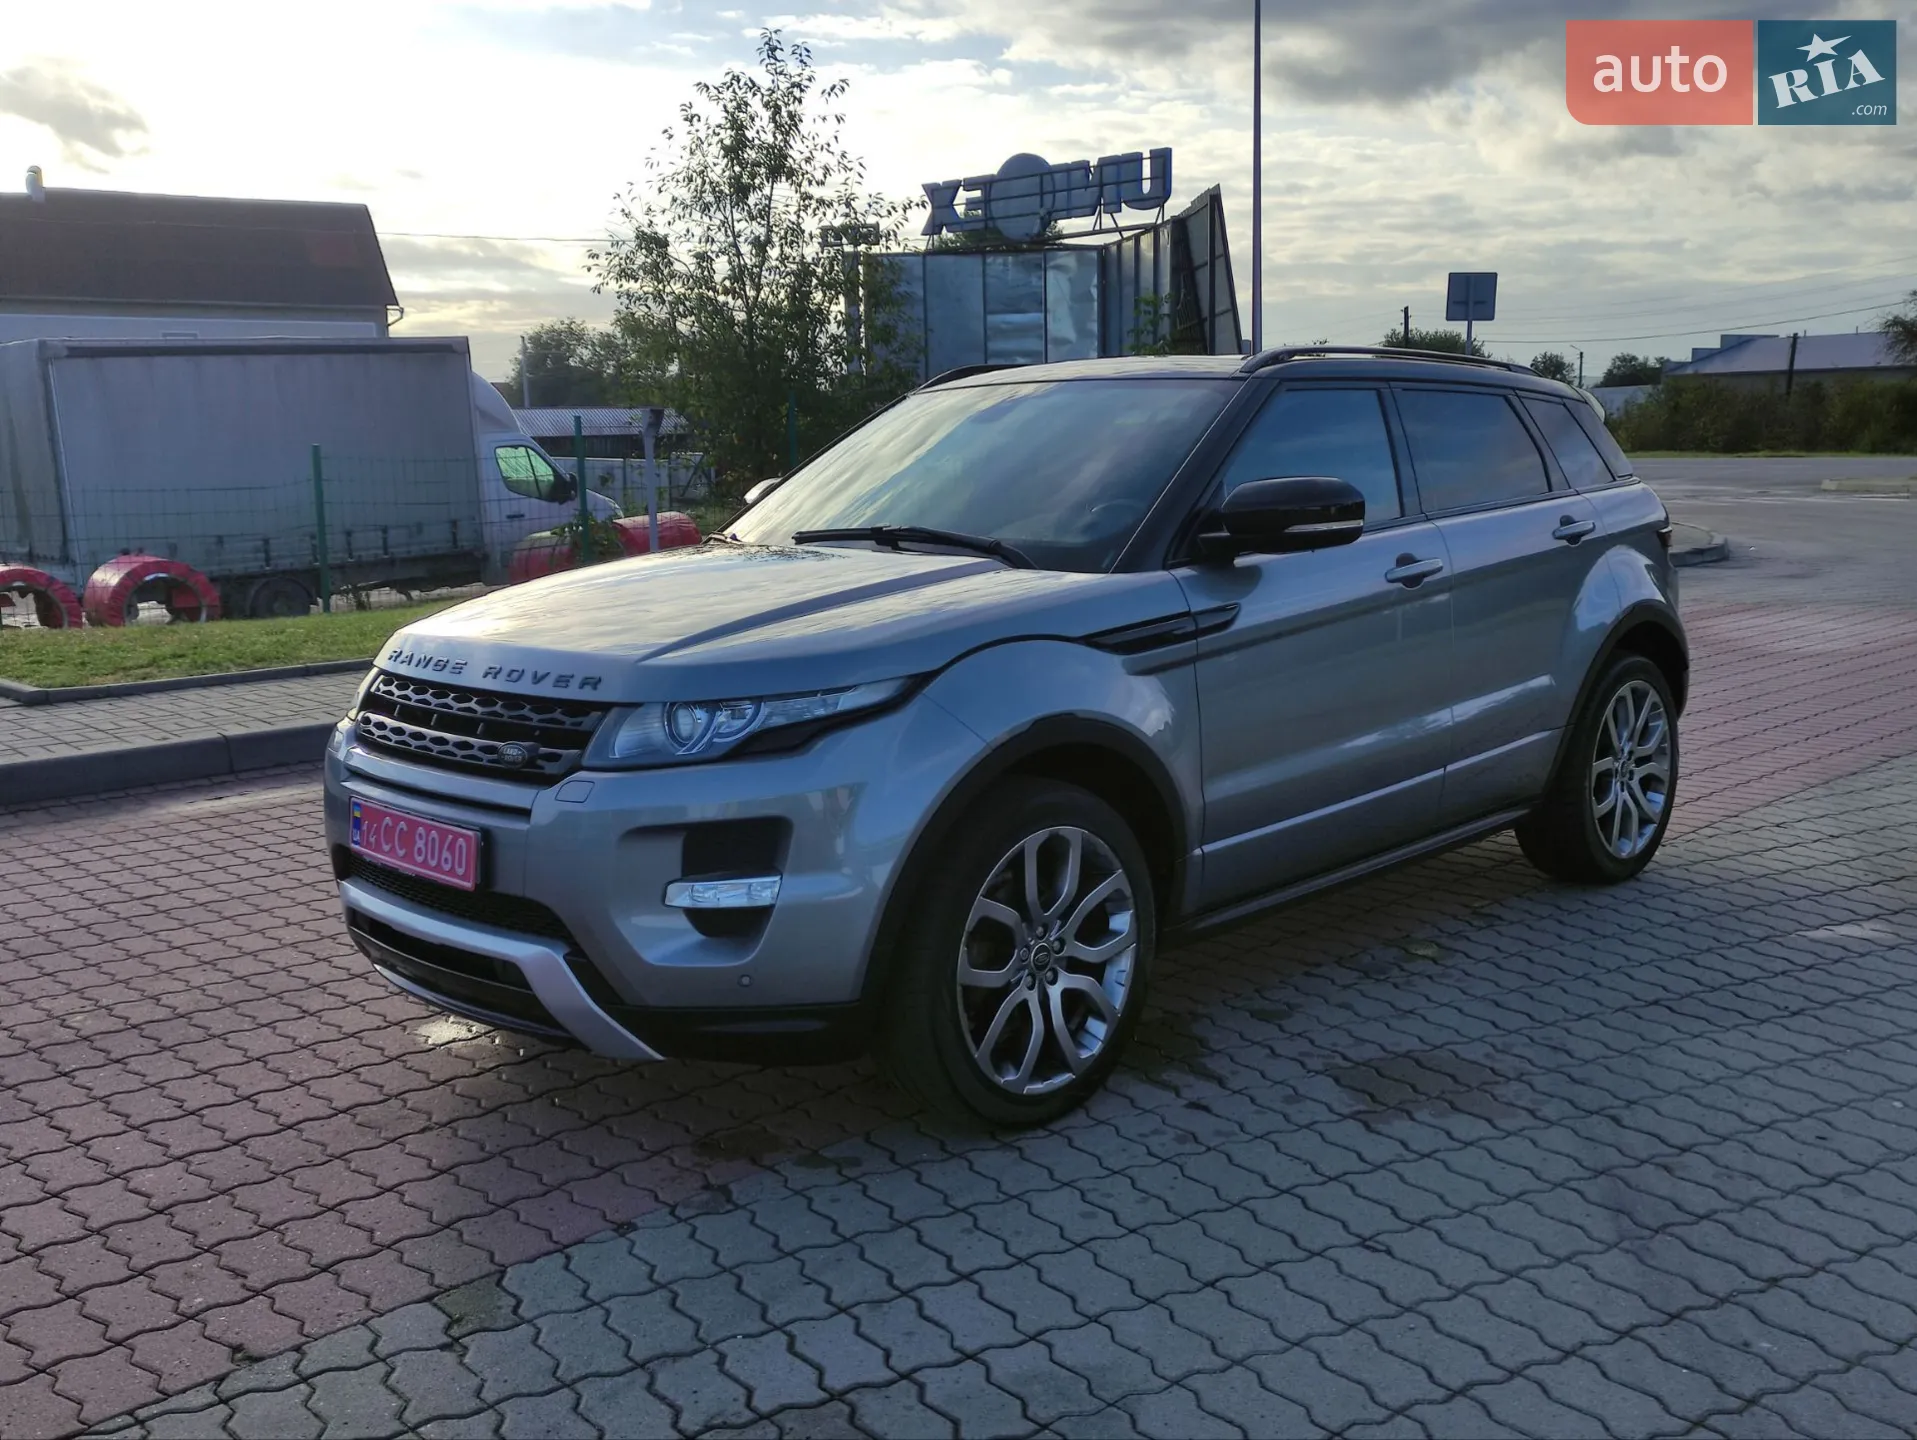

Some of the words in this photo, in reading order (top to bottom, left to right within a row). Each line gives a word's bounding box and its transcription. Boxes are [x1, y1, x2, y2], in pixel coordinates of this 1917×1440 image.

[387, 648, 468, 675] RANGE
[483, 664, 602, 691] ROVER
[381, 816, 408, 857] CC
[413, 826, 467, 876] 8060
